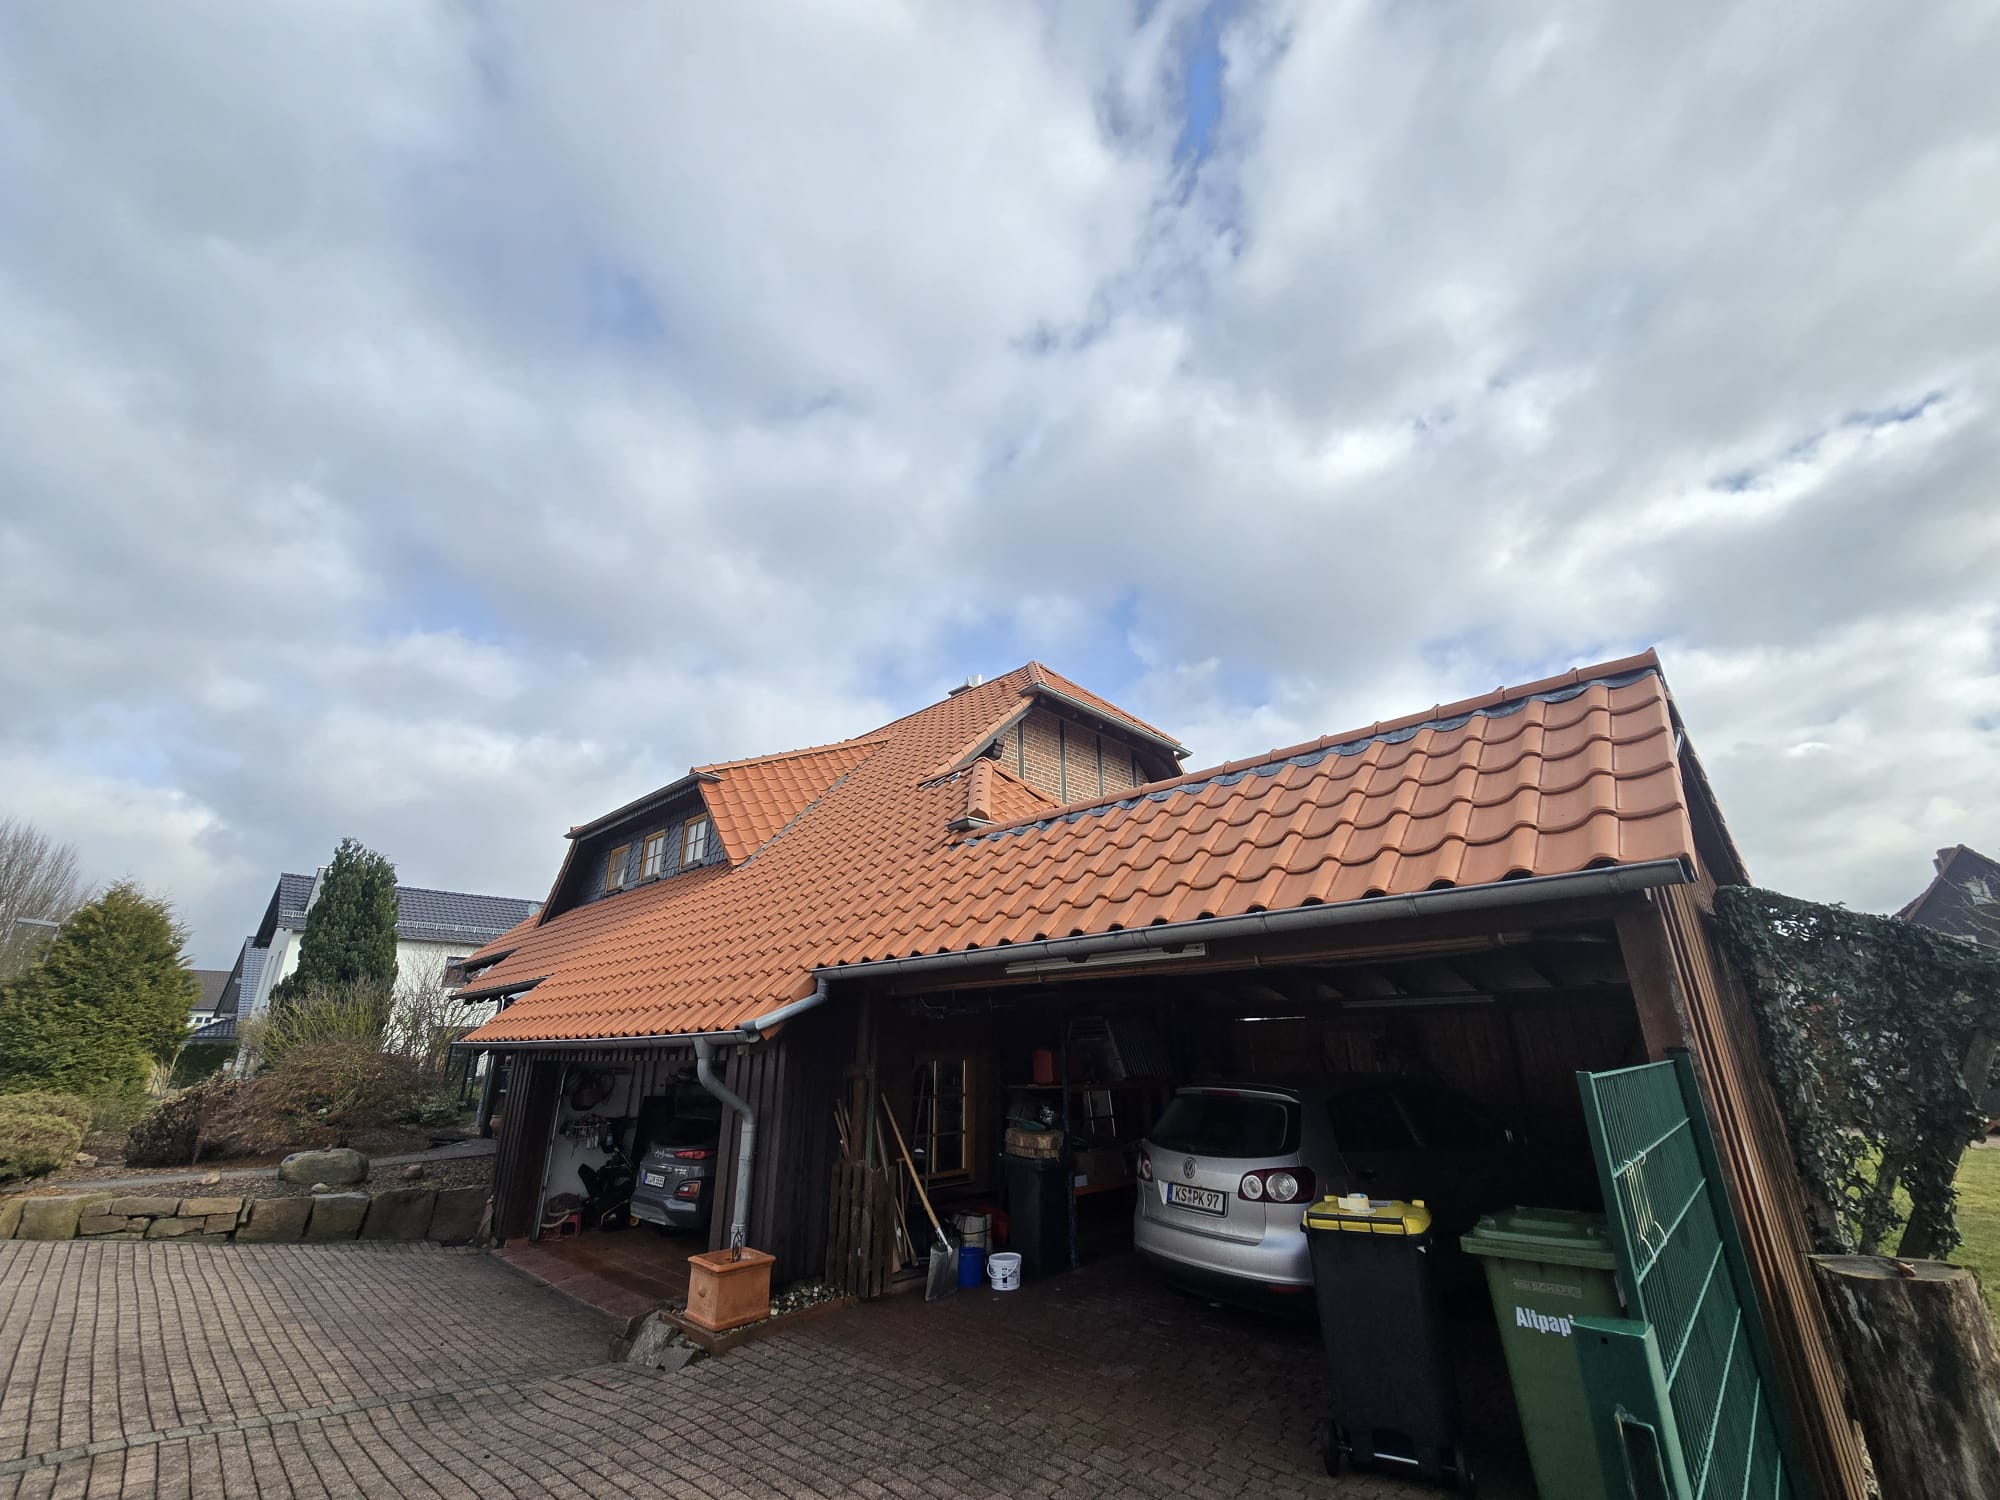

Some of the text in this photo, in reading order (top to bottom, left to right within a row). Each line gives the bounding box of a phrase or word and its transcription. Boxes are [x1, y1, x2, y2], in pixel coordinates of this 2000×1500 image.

[1175, 1187, 1219, 1208] KS PK 97
